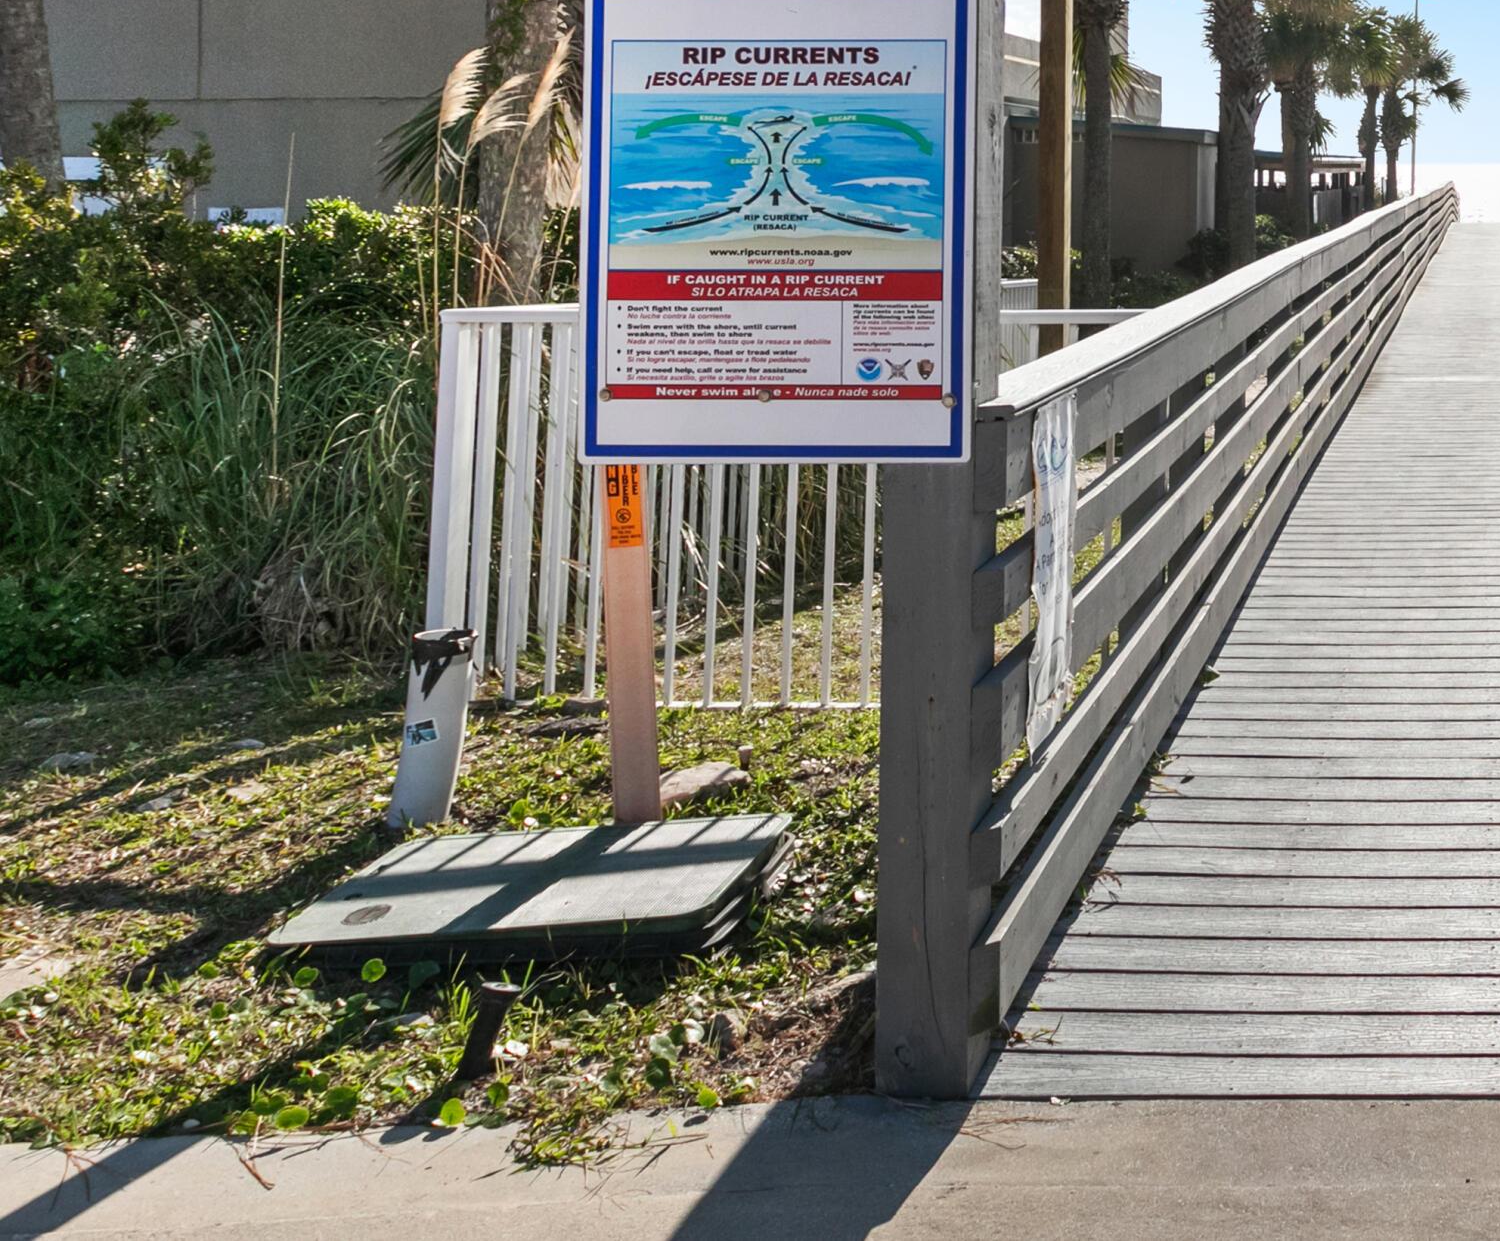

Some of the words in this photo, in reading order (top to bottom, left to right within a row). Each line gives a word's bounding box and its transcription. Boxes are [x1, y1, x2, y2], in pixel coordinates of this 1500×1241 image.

[682, 46, 726, 64] RIP
[734, 46, 879, 64] CURRENTS
[760, 71, 789, 86] DE
[792, 71, 818, 86] LA
[823, 71, 911, 86] RESACA!
[743, 213, 760, 221] RIP
[762, 213, 808, 221] CURRENT
[752, 223, 797, 231] (RESACA)
[709, 247, 852, 257] www.ripcurrents.noaa.gov
[666, 274, 680, 284] IF
[684, 274, 746, 284] CAUGHT
[750, 274, 766, 284] IN
[770, 274, 781, 284] A
[784, 274, 809, 284] RIP
[813, 274, 884, 284] CURRENT
[690, 286, 704, 296] SI
[706, 286, 725, 297] LO
[727, 286, 779, 296] ATRAPA
[782, 286, 800, 296] LA
[803, 286, 858, 297] RESACA
[655, 386, 697, 396] Never
[701, 386, 738, 396] swim
[743, 387, 782, 396] ale
[793, 386, 834, 396] Nunca
[837, 386, 868, 396] nade
[871, 387, 899, 396] solo
